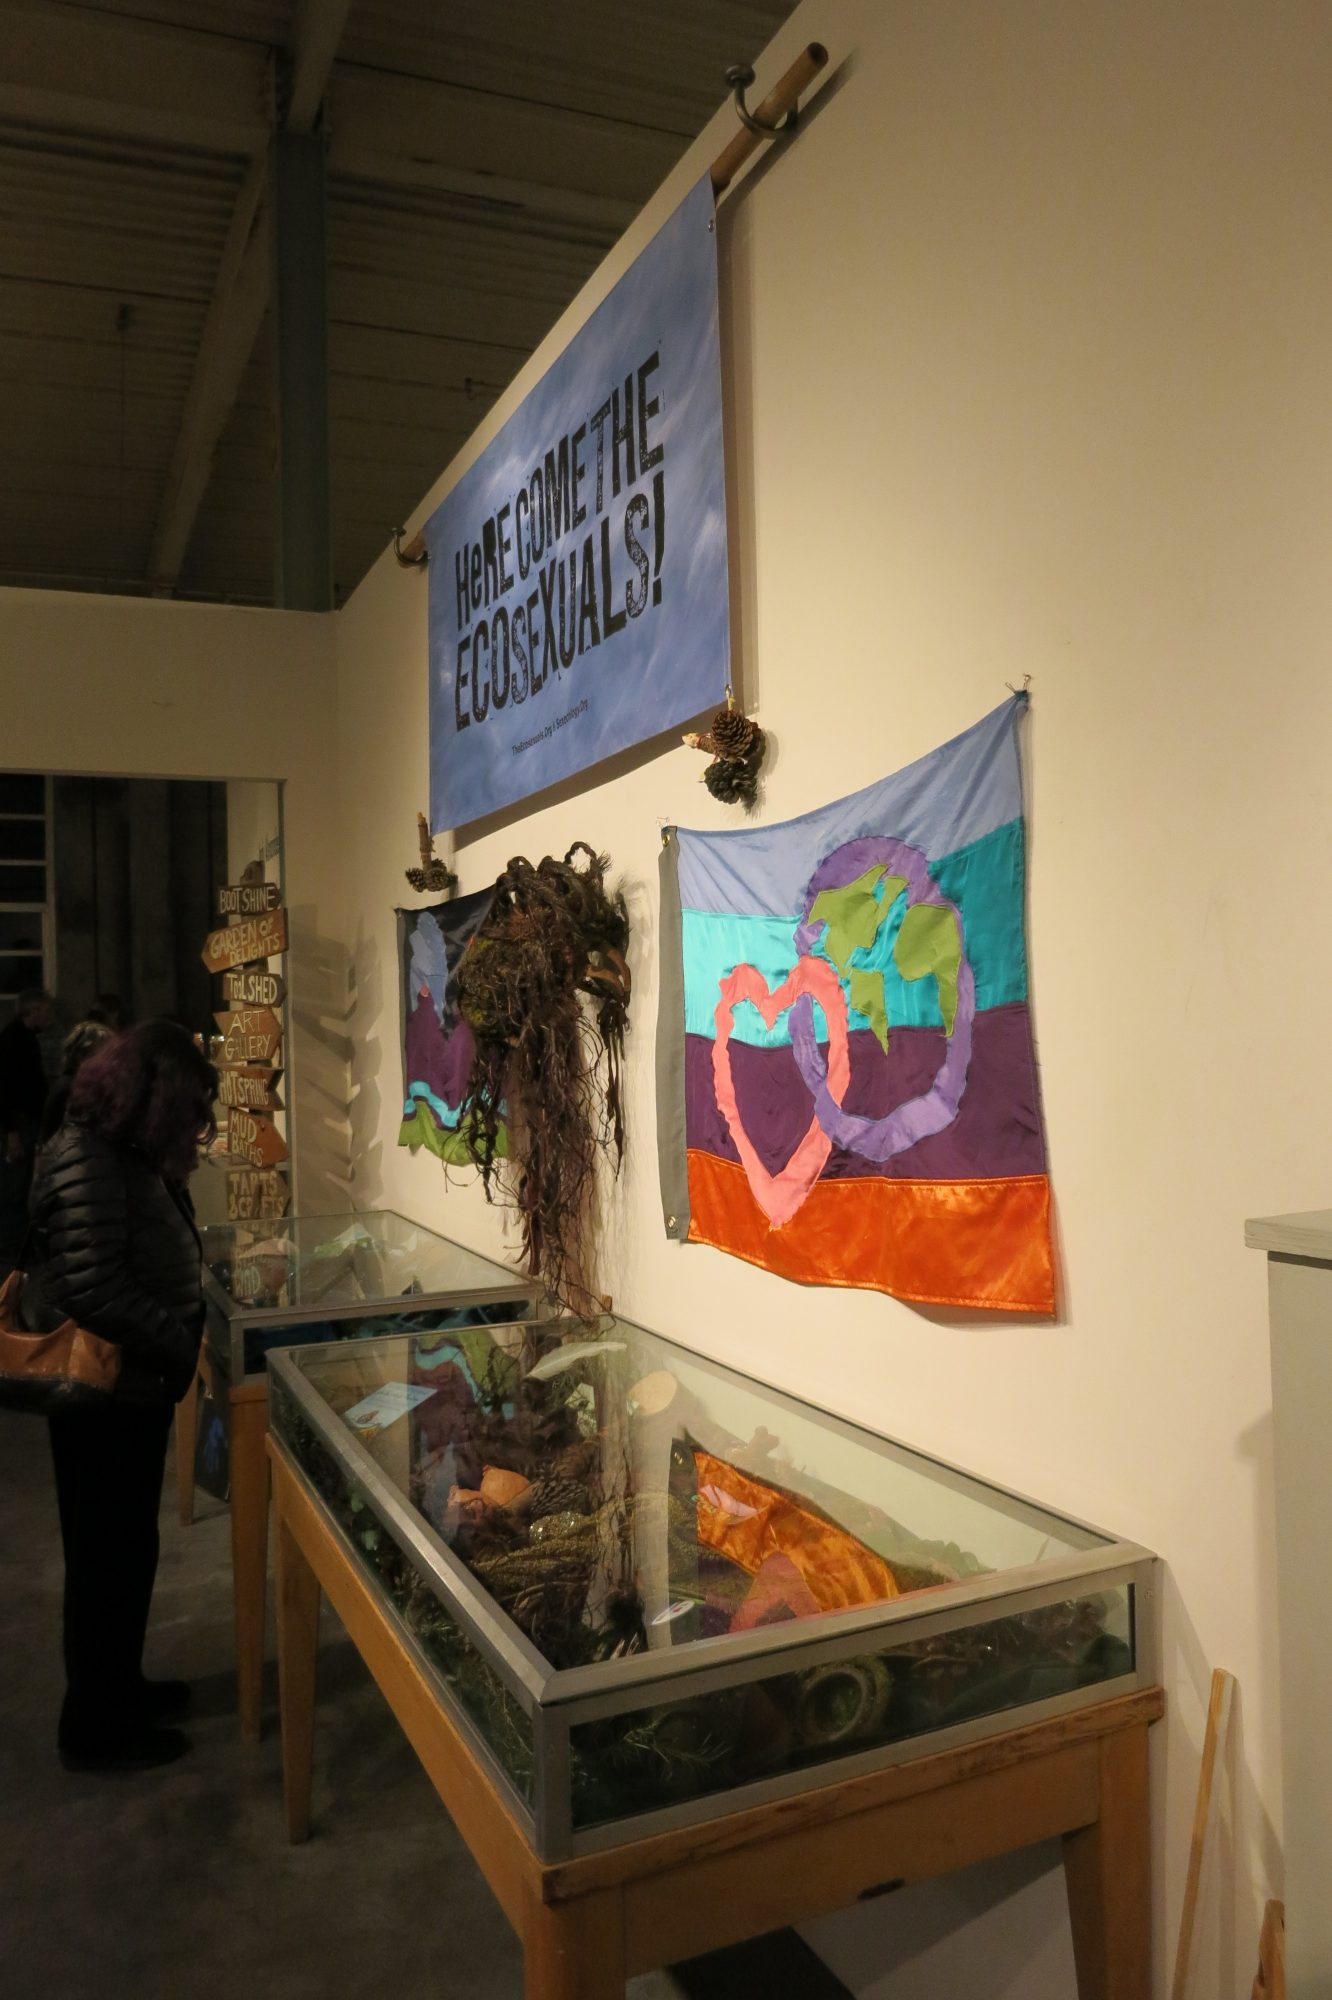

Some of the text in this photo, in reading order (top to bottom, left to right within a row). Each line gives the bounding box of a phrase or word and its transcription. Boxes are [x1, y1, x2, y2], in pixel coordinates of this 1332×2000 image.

[515, 422, 587, 579] COME
[590, 351, 664, 515] THE
[455, 470, 665, 732] ECOSEXUALS!
[219, 886, 276, 913] BOOT SHINE
[210, 917, 274, 959] GARDEN OF
[229, 933, 280, 965] DELIGHTS
[247, 975, 278, 1005] SHED
[228, 1009, 266, 1035] ART
[219, 1070, 239, 1105] HOT
[229, 1111, 258, 1142] MUD
[231, 1132, 264, 1168] BATHS
